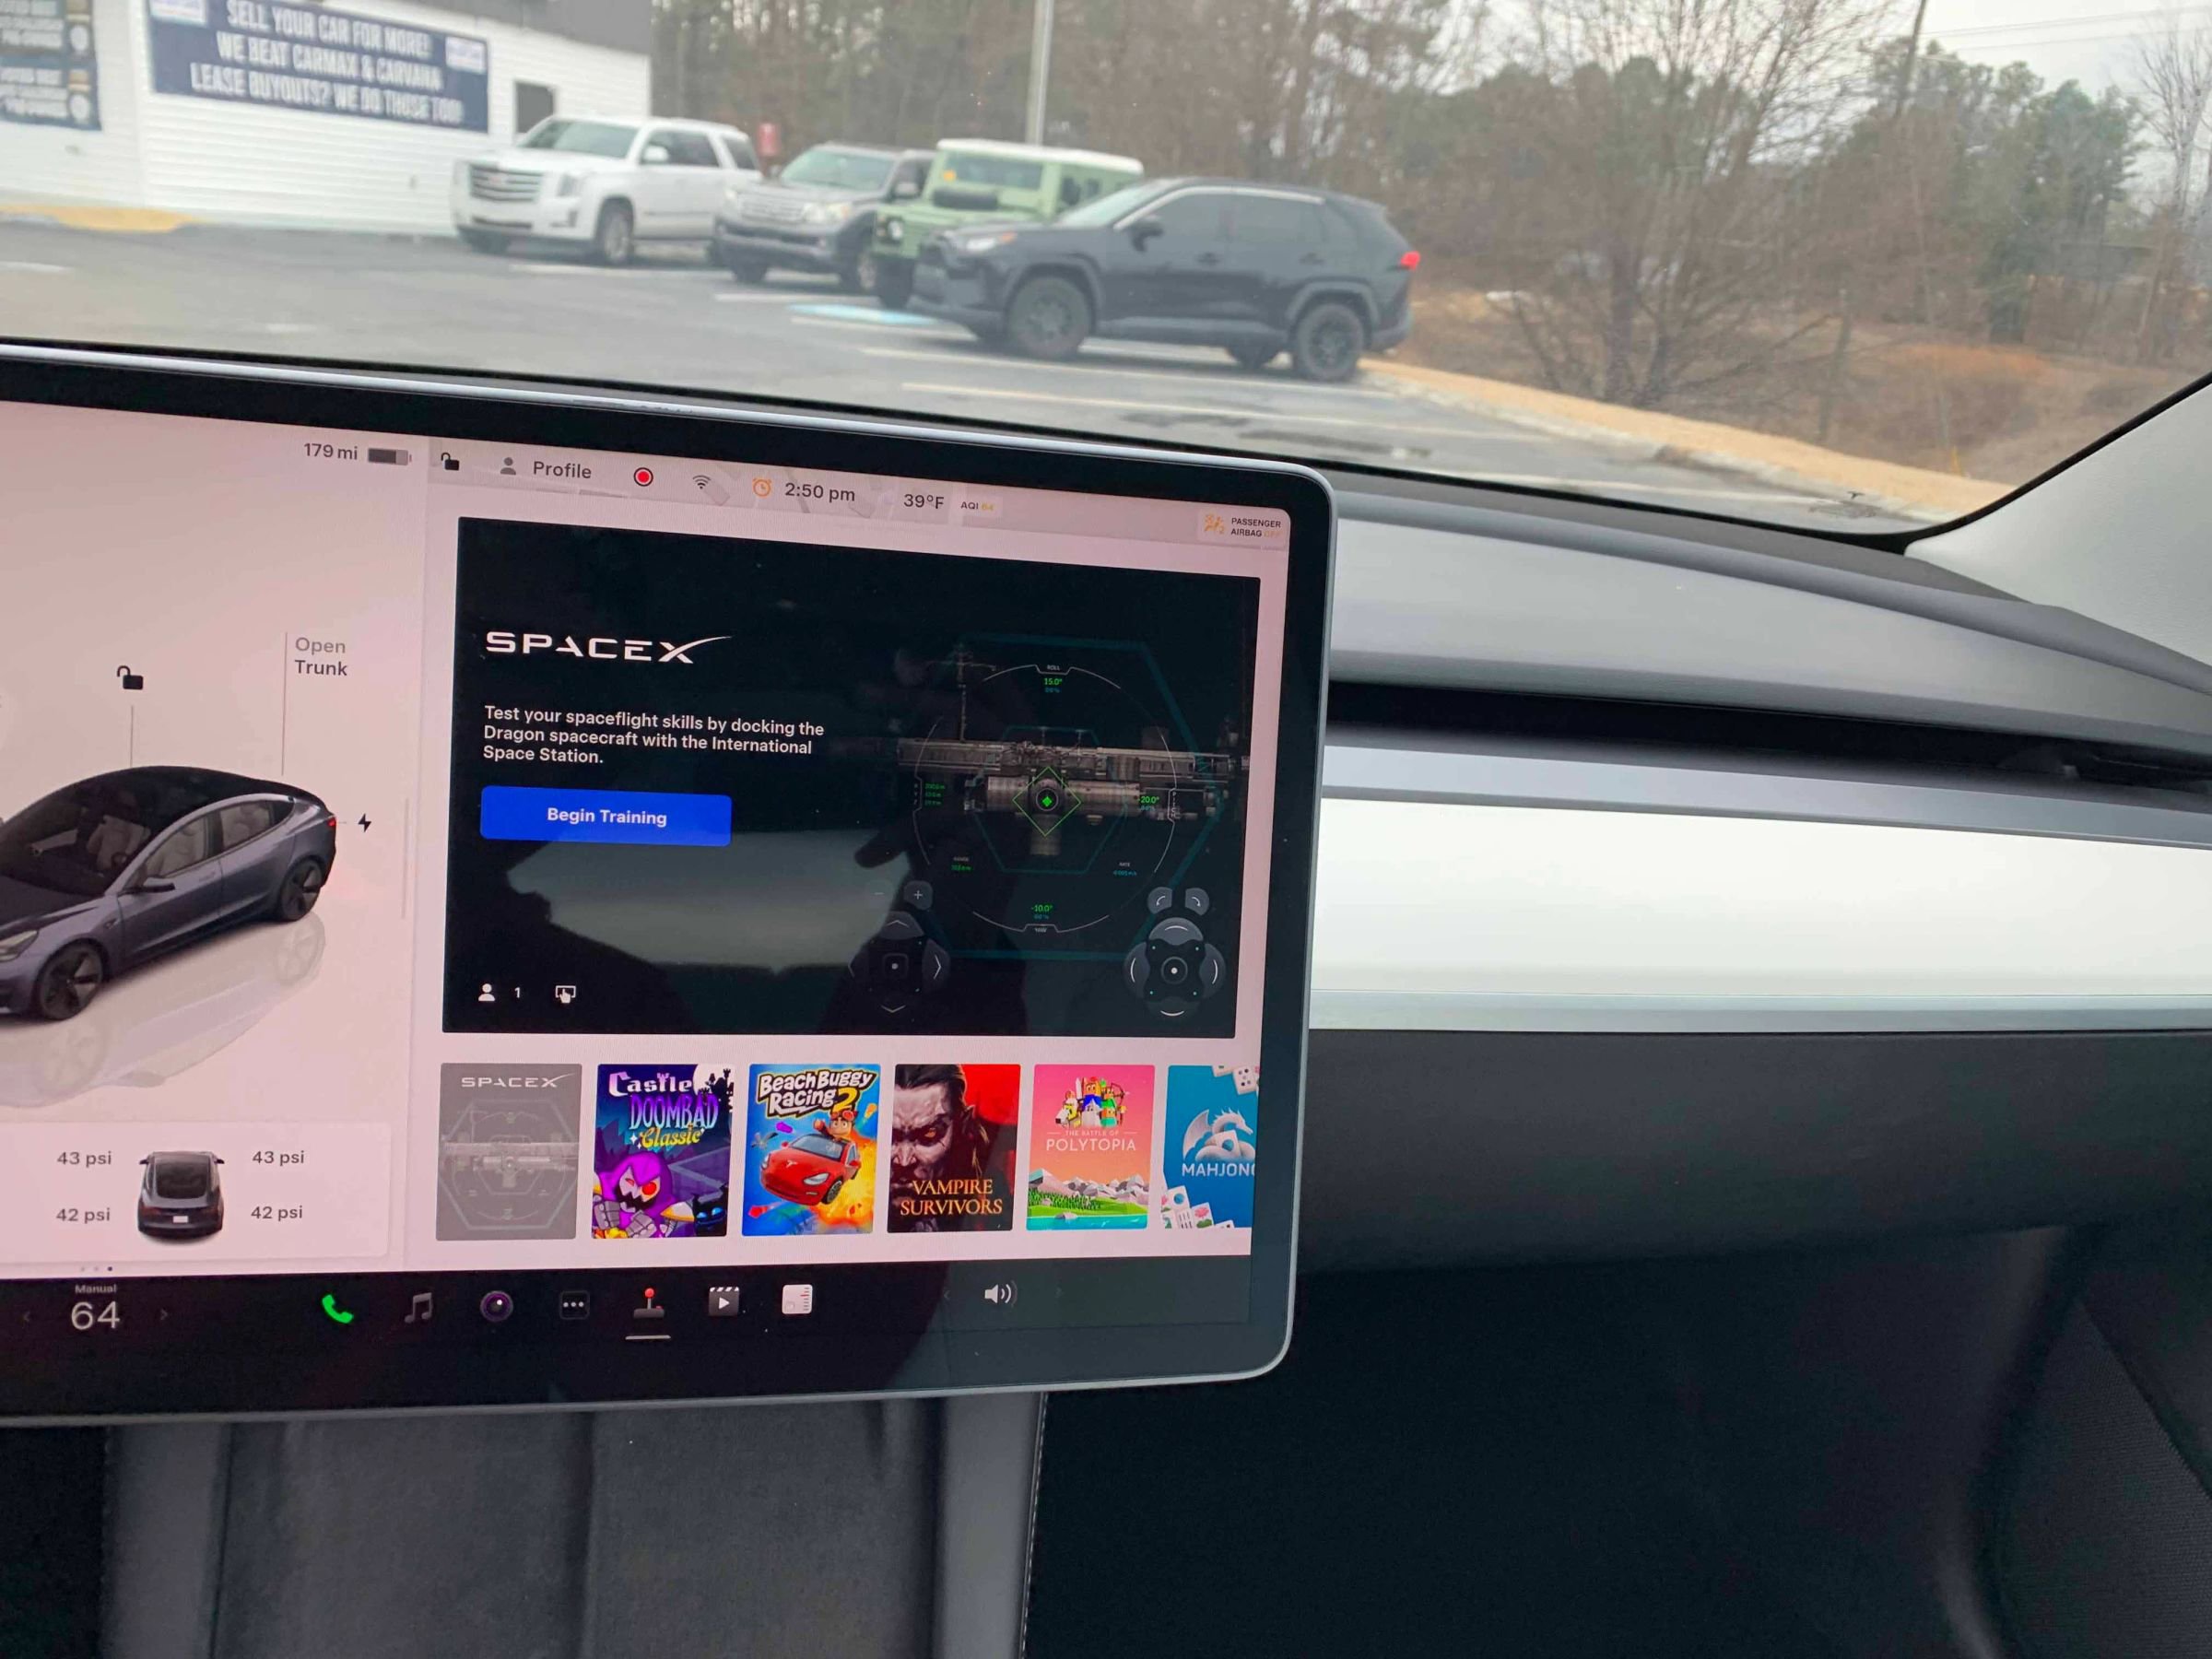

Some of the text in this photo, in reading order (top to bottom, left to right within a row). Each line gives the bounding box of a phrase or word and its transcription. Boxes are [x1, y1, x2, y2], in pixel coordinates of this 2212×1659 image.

[227, 0, 270, 32] SELL
[272, 6, 316, 39] YOUR
[318, 15, 350, 45] CAR
[353, 20, 382, 51] FOR
[217, 30, 444, 91] WE BEAT CARMAX & CARVANA
[190, 63, 247, 97] LEASE
[249, 71, 332, 106] BUYOUTS?
[333, 82, 359, 112] WE
[304, 442, 359, 461] 179 mi
[533, 461, 592, 479] Profile
[785, 482, 855, 504] 2:50 pm
[903, 493, 945, 510] 39°F
[960, 500, 979, 510] AQI
[1231, 517, 1281, 528] PASSENGER
[1230, 528, 1263, 537] AIRBAG
[295, 637, 347, 655] Open
[486, 630, 734, 665] SPACEX
[295, 659, 347, 676] Trunk
[484, 705, 825, 737] Test your spaceflight skills by docking the
[484, 725, 812, 755] Dragon spacecraft with the International
[483, 745, 604, 764] Space Station.
[547, 807, 667, 827] Begin Training
[513, 986, 521, 999] 1
[461, 1072, 576, 1088] SPACEX
[608, 1070, 692, 1098] Castle
[759, 1070, 874, 1098] Beach Buggy
[770, 1087, 858, 1114] Racing 2
[629, 1092, 720, 1130] DOOMBAD
[639, 1126, 703, 1149] Classic
[1046, 1138, 1136, 1151] POLYTOPIA
[56, 1151, 112, 1169] 43 psi
[253, 1149, 305, 1168] 43 psi
[912, 1179, 993, 1195] VAMPIRE
[56, 1207, 111, 1225] 42 psi
[251, 1205, 303, 1222] 42 psi
[900, 1198, 1004, 1217] SURVIVORS
[75, 1284, 117, 1294] Manual
[71, 1300, 121, 1330] 64
